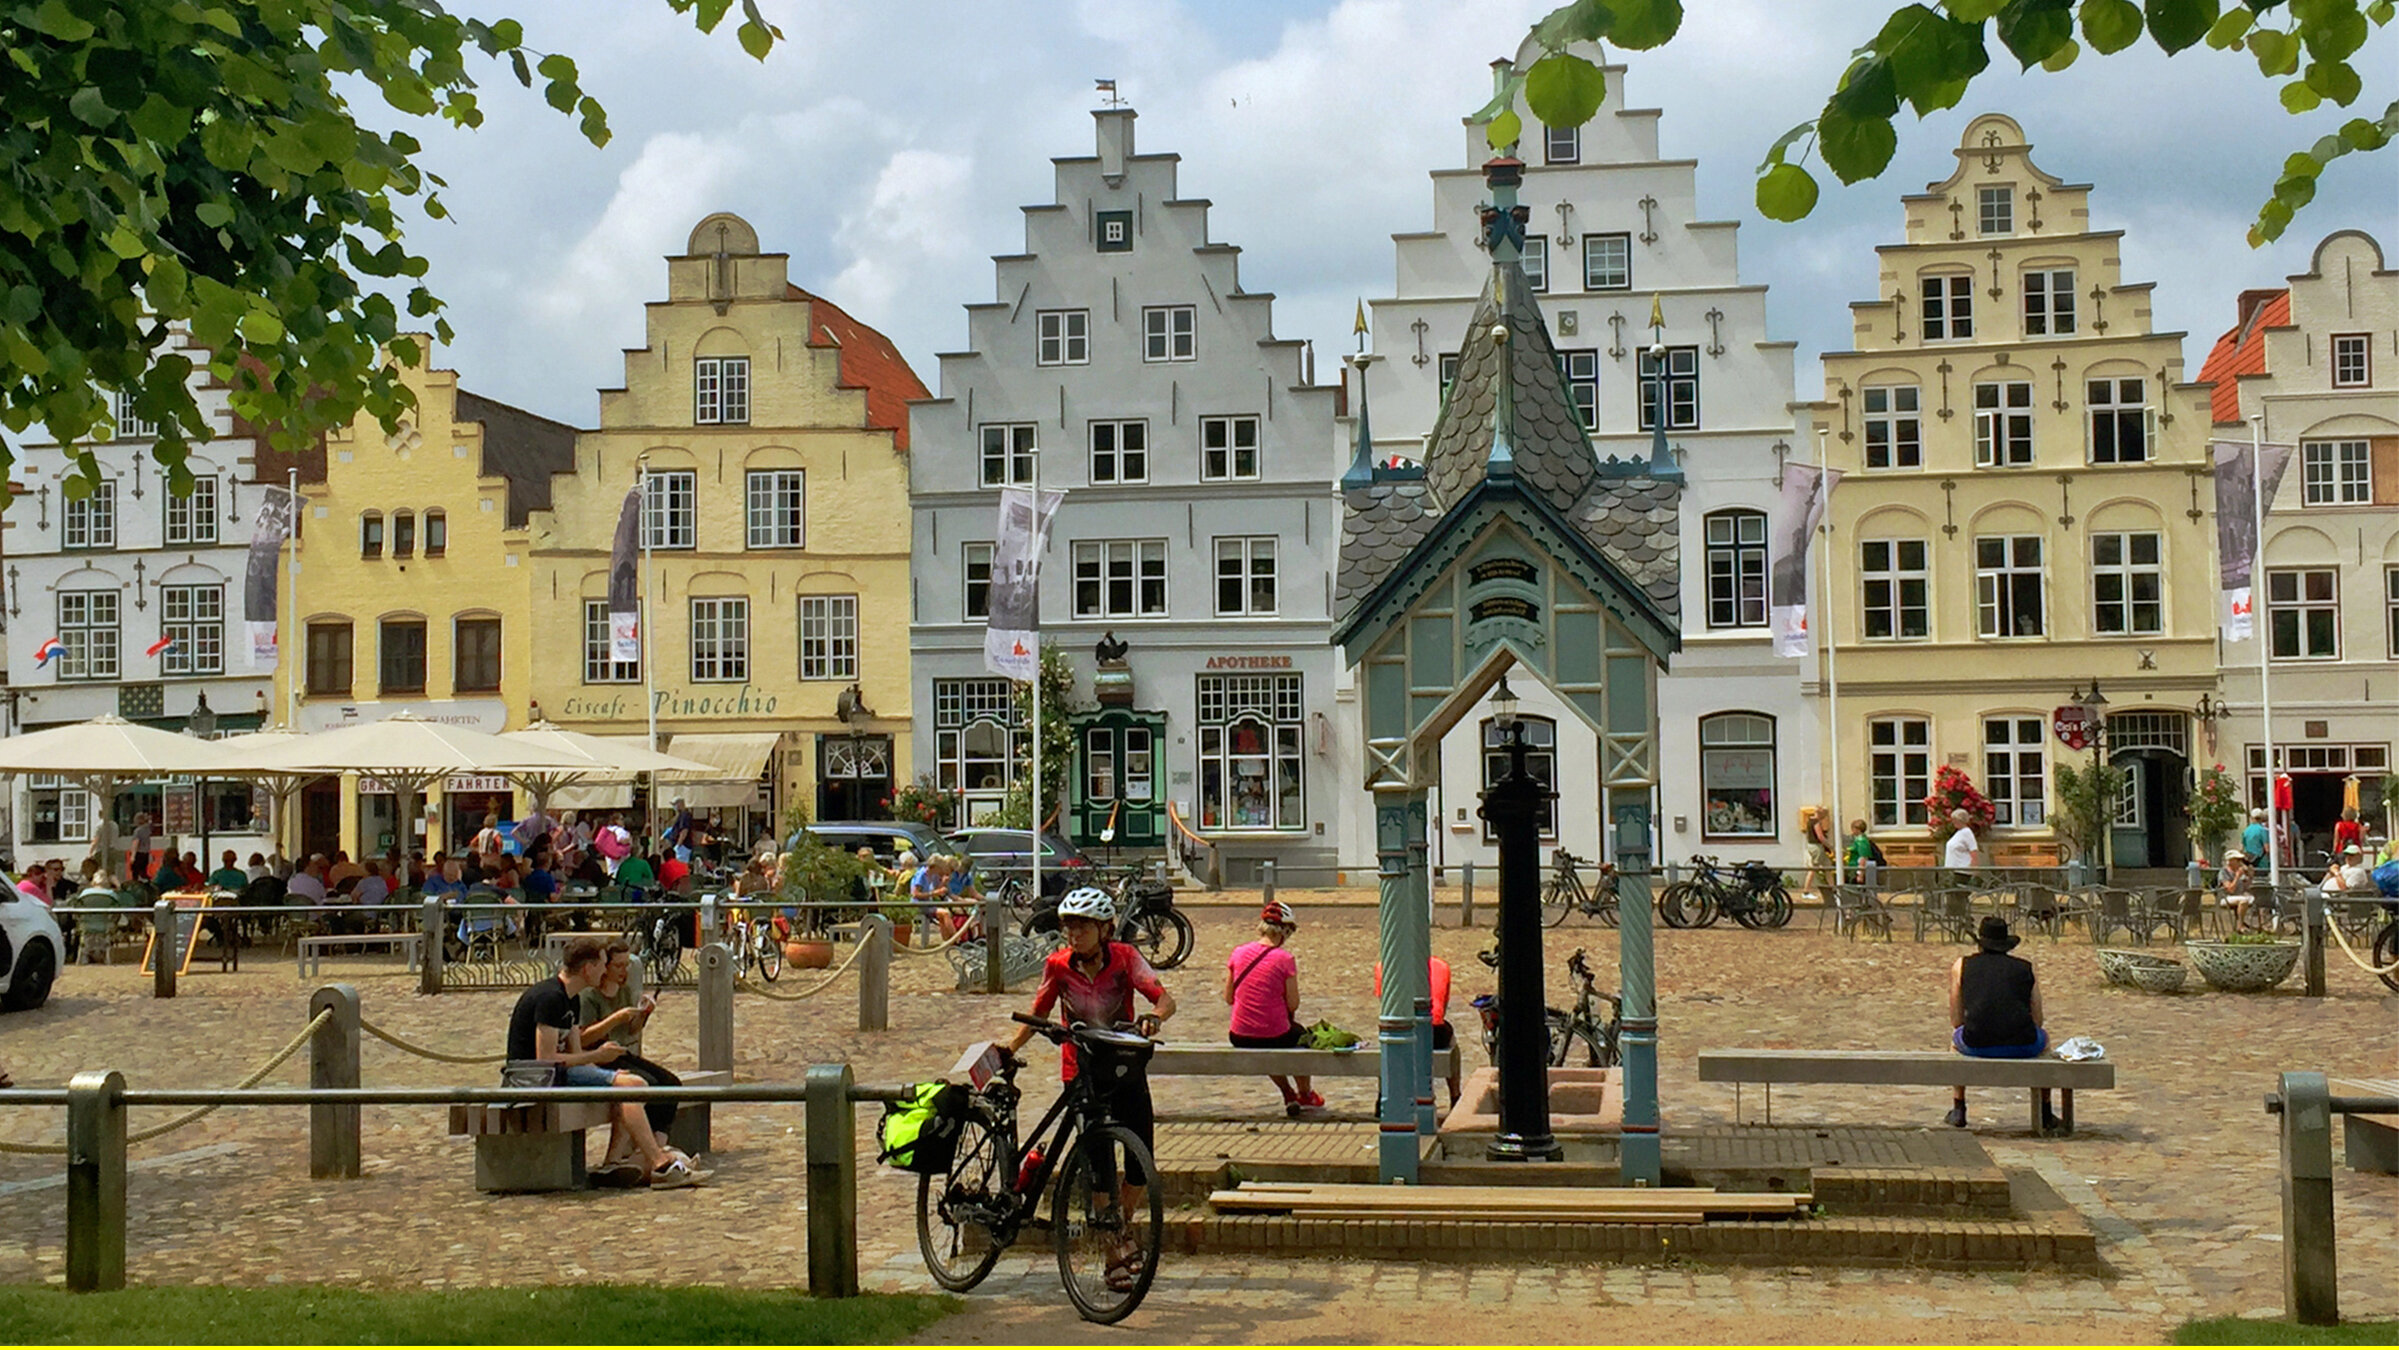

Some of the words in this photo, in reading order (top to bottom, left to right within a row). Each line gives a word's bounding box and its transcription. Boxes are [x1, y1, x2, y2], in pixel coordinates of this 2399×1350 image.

[1206, 656, 1293, 669] APOTHEKE
[655, 684, 778, 715] Pinocchio
[448, 777, 510, 790] FAHRTEN
